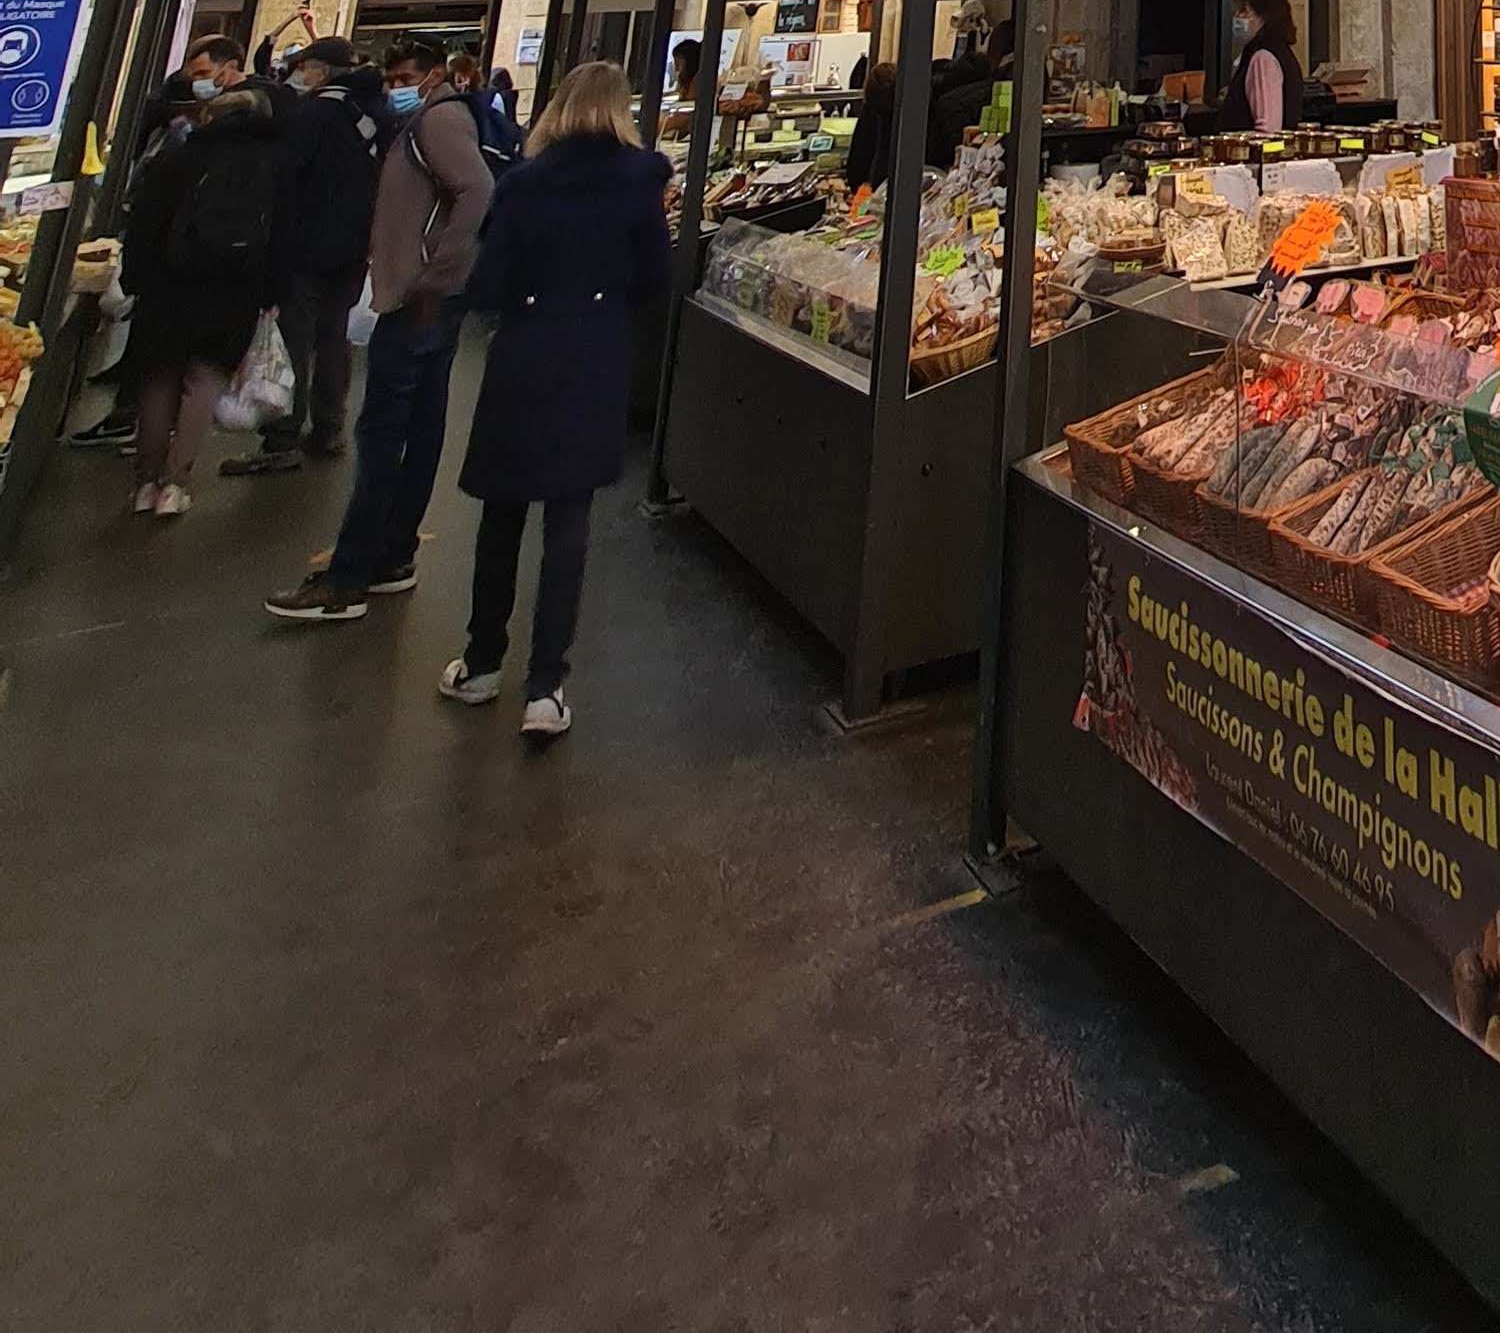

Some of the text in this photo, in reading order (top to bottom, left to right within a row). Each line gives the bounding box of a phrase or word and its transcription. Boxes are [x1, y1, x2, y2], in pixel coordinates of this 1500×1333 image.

[0, 10, 57, 21] LIGATOIRE
[1127, 574, 1326, 738] Saucissonnerie
[1333, 693, 1376, 770] de
[1383, 716, 1420, 801] la
[1165, 661, 1265, 764] Saucissons
[1268, 728, 1287, 781] &
[1293, 744, 1463, 901] Champignons
[1310, 826, 1328, 862] 76
[1352, 861, 1372, 894] 46
[1374, 874, 1395, 913] 95
